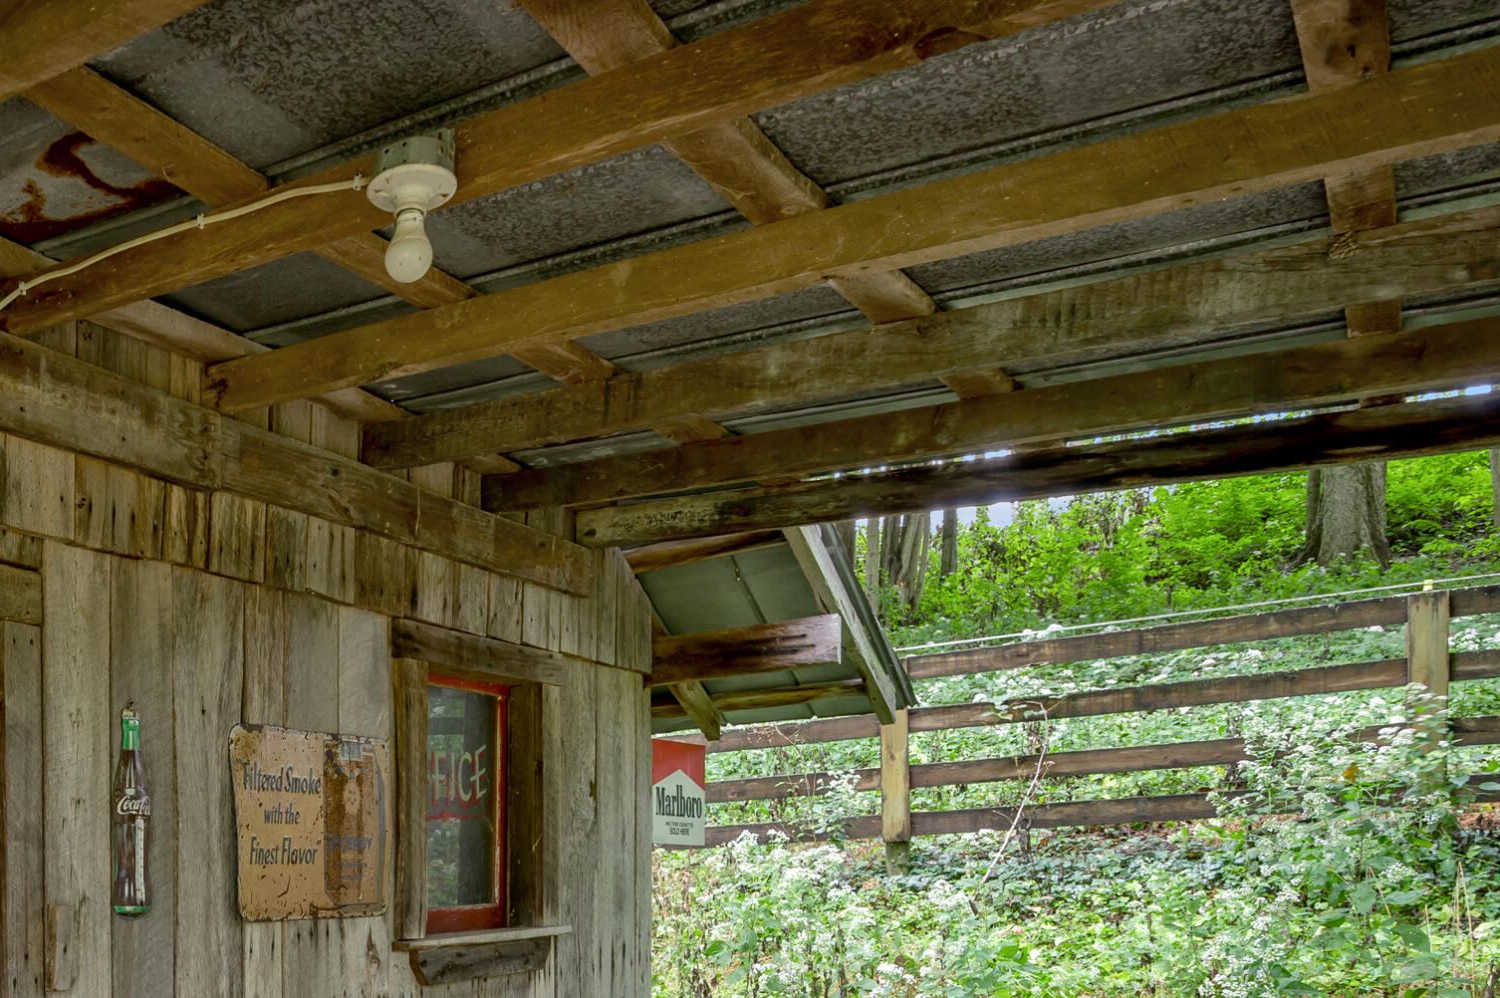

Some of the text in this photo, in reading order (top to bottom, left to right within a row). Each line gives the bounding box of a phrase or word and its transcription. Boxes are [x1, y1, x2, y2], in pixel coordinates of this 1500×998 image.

[284, 765, 322, 795] Smoke
[429, 744, 487, 803] FICE
[263, 801, 301, 825] with the
[655, 784, 702, 819] Marlboro
[249, 835, 279, 865] Finest
